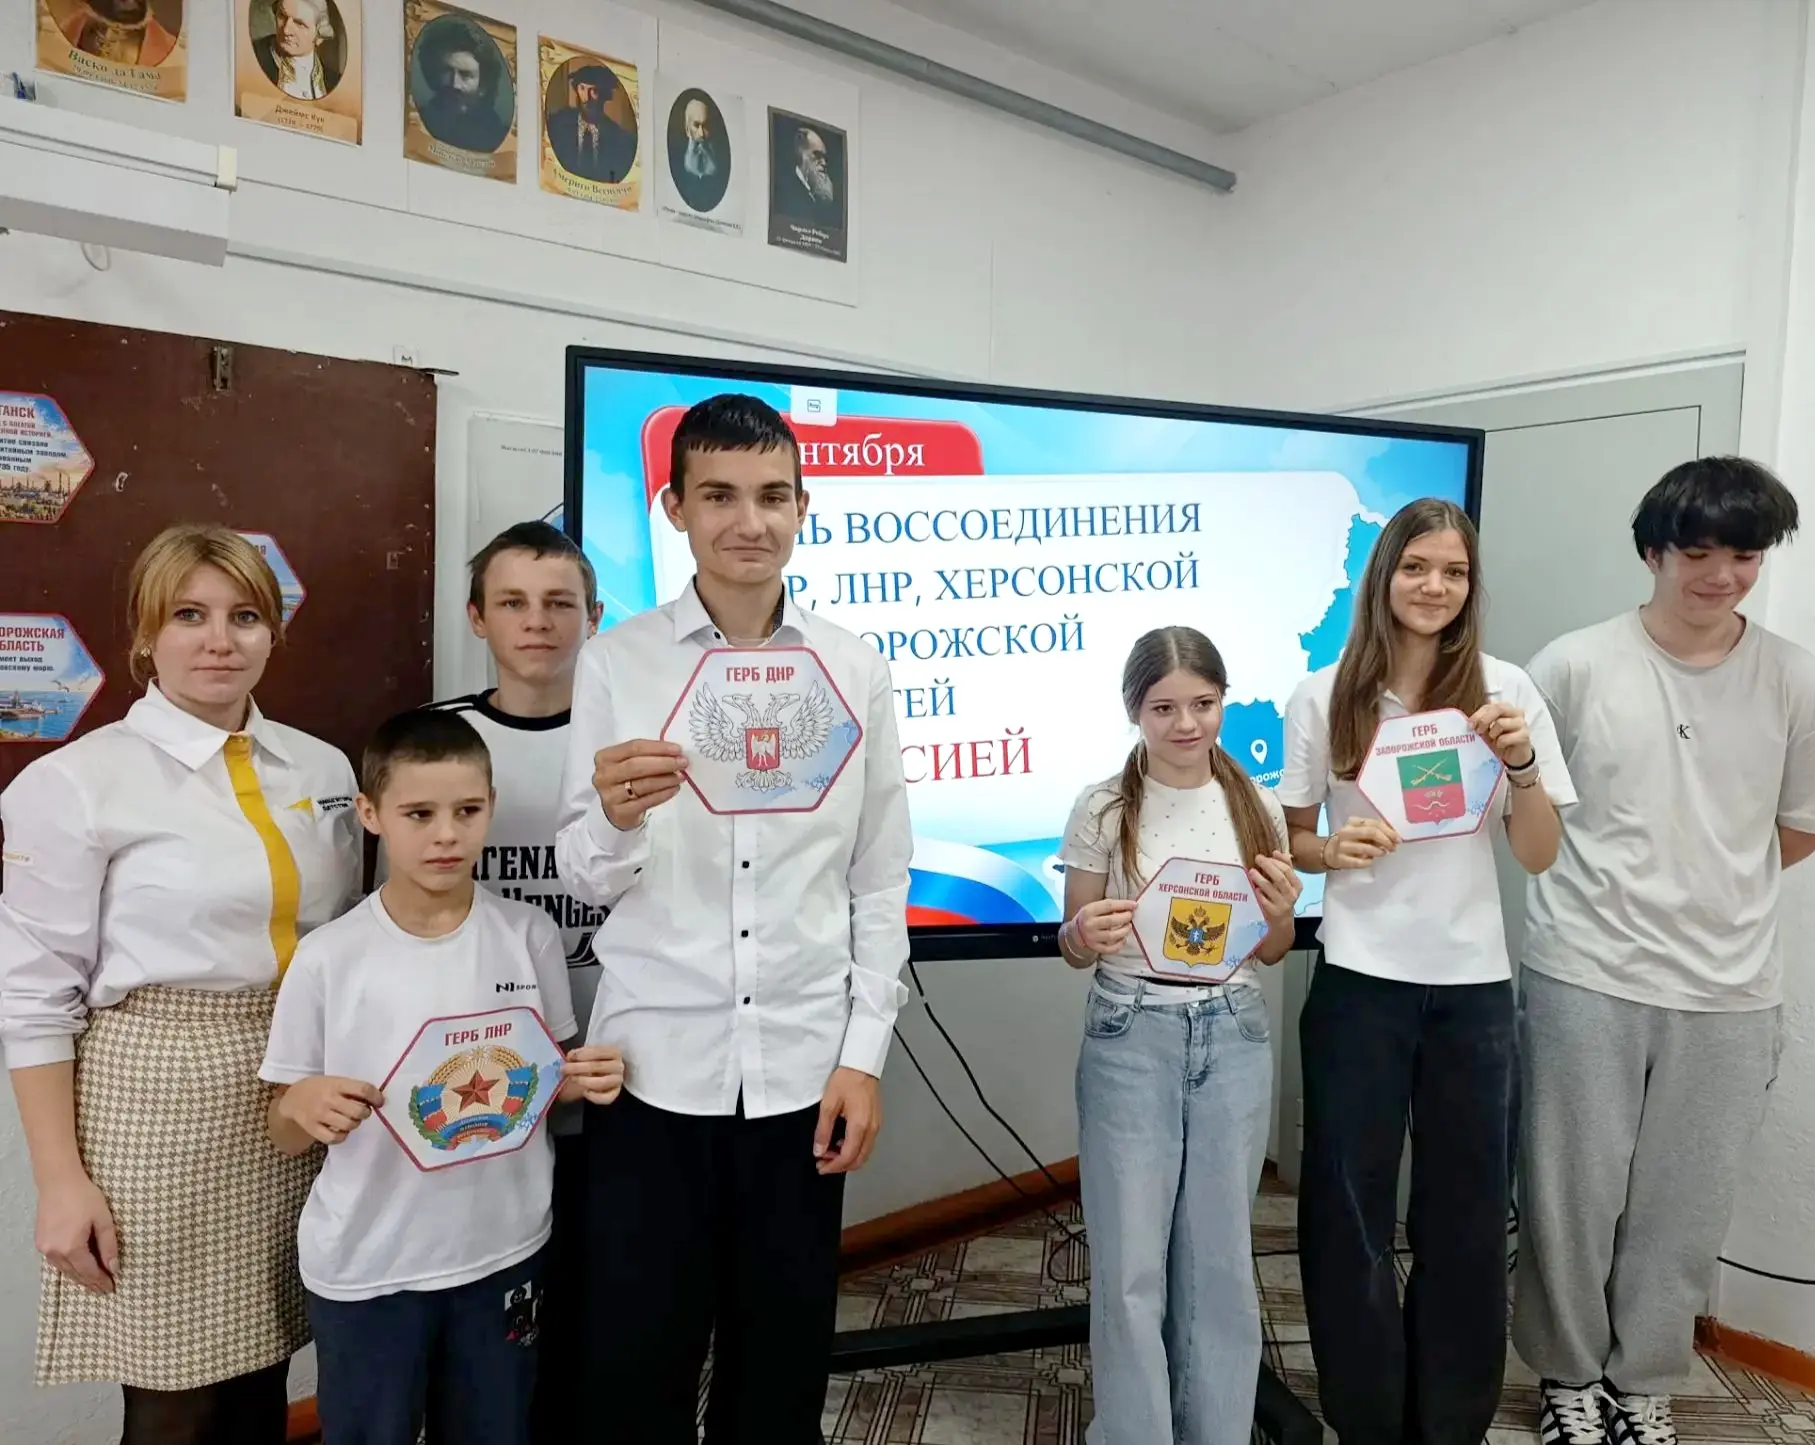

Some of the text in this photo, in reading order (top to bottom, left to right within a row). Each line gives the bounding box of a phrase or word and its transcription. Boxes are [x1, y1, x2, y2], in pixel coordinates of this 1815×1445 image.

[843, 503, 1202, 546] ВОССОЕДИНЕНИЯ
[830, 571, 921, 607] ЛНР,
[934, 551, 1200, 600] ХЕРСОНСКОЙ
[726, 667, 795, 683] ГЕРБ ДНР
[1412, 724, 1438, 737] ГЕРБ
[1375, 734, 1476, 756] ЗАПОРОЖСКОЙ ОБЛАСТИ
[1195, 872, 1220, 886] ГЕРБ
[1158, 883, 1248, 903] ХЕРСОНСКОЙ ОБЛАСТИ
[444, 1023, 512, 1046] ГЕРБ ЛНР
